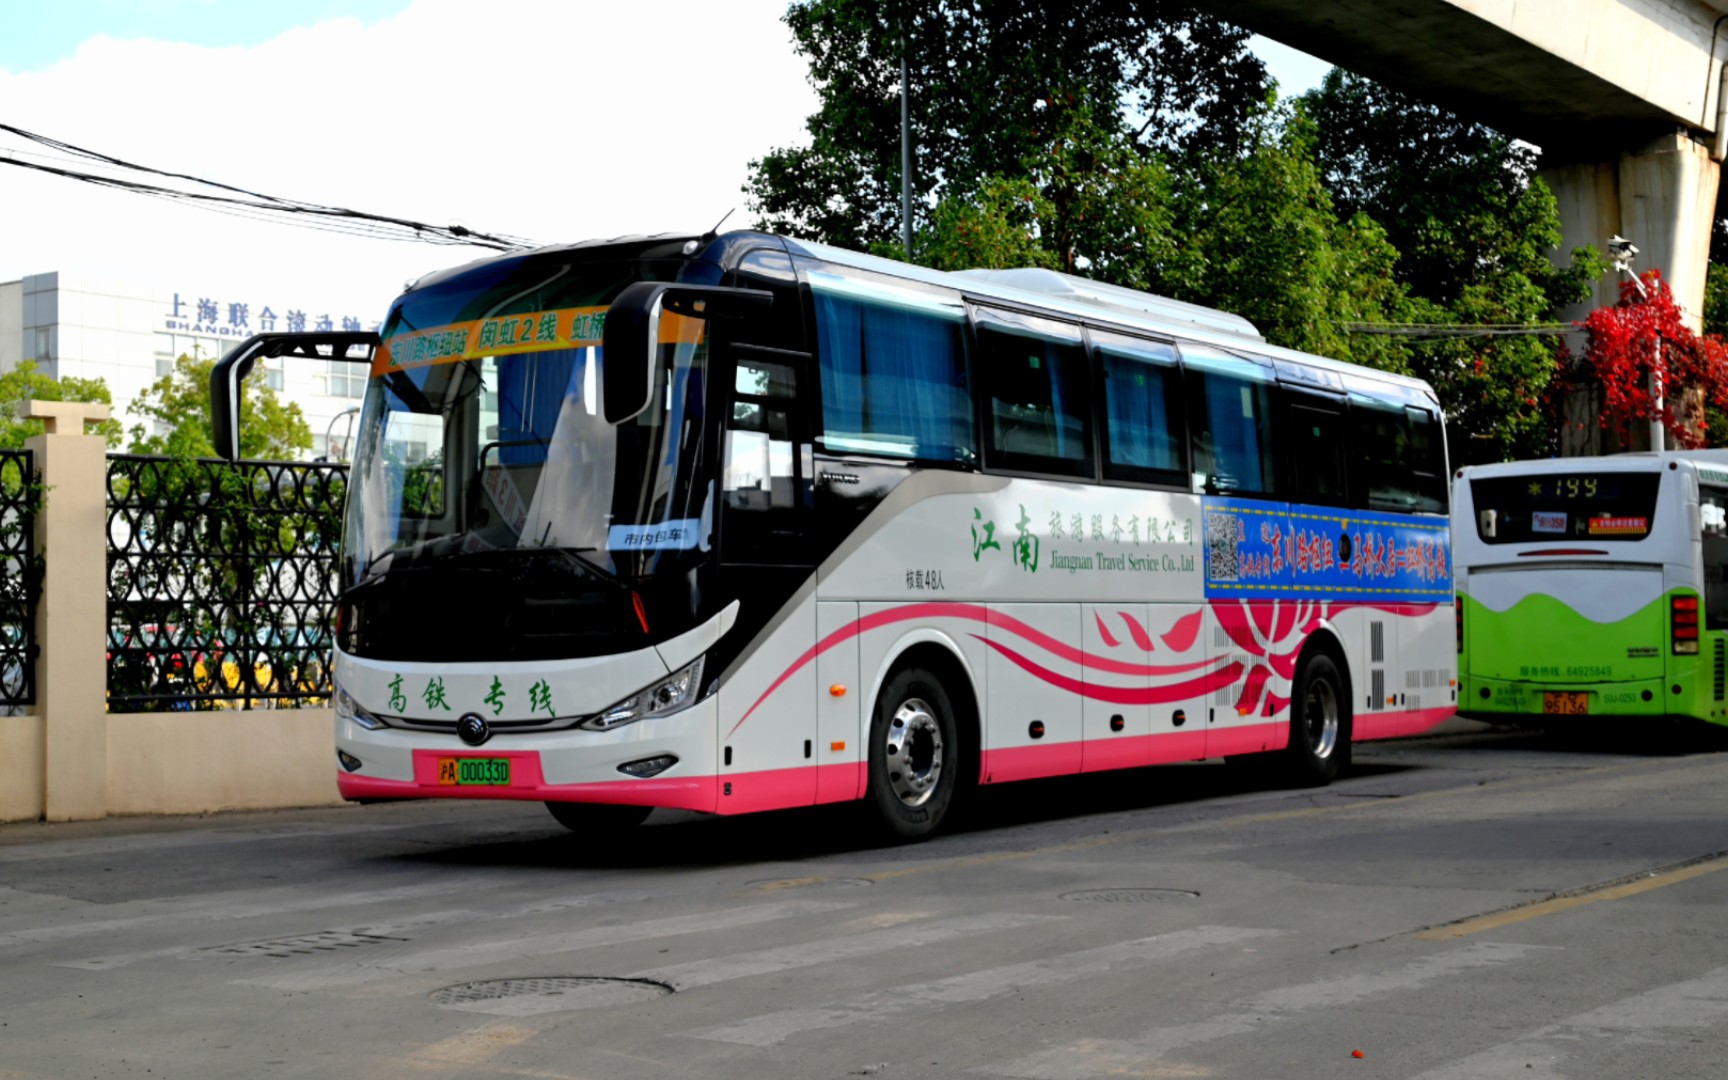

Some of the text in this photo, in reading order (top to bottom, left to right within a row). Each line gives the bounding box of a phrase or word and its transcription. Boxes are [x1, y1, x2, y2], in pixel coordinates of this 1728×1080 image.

[165, 293, 384, 333] 上海联合滚动轴
[478, 311, 558, 350] 闵虹2线
[1555, 477, 1597, 498] 199
[971, 503, 1194, 573] 江南 旅游服务有限公司
[906, 568, 945, 591] 核载48人
[1049, 550, 1093, 574] Jiangnan
[1096, 552, 1126, 571] Travel
[1128, 554, 1159, 572] Service
[387, 673, 556, 718] 高铁专线
